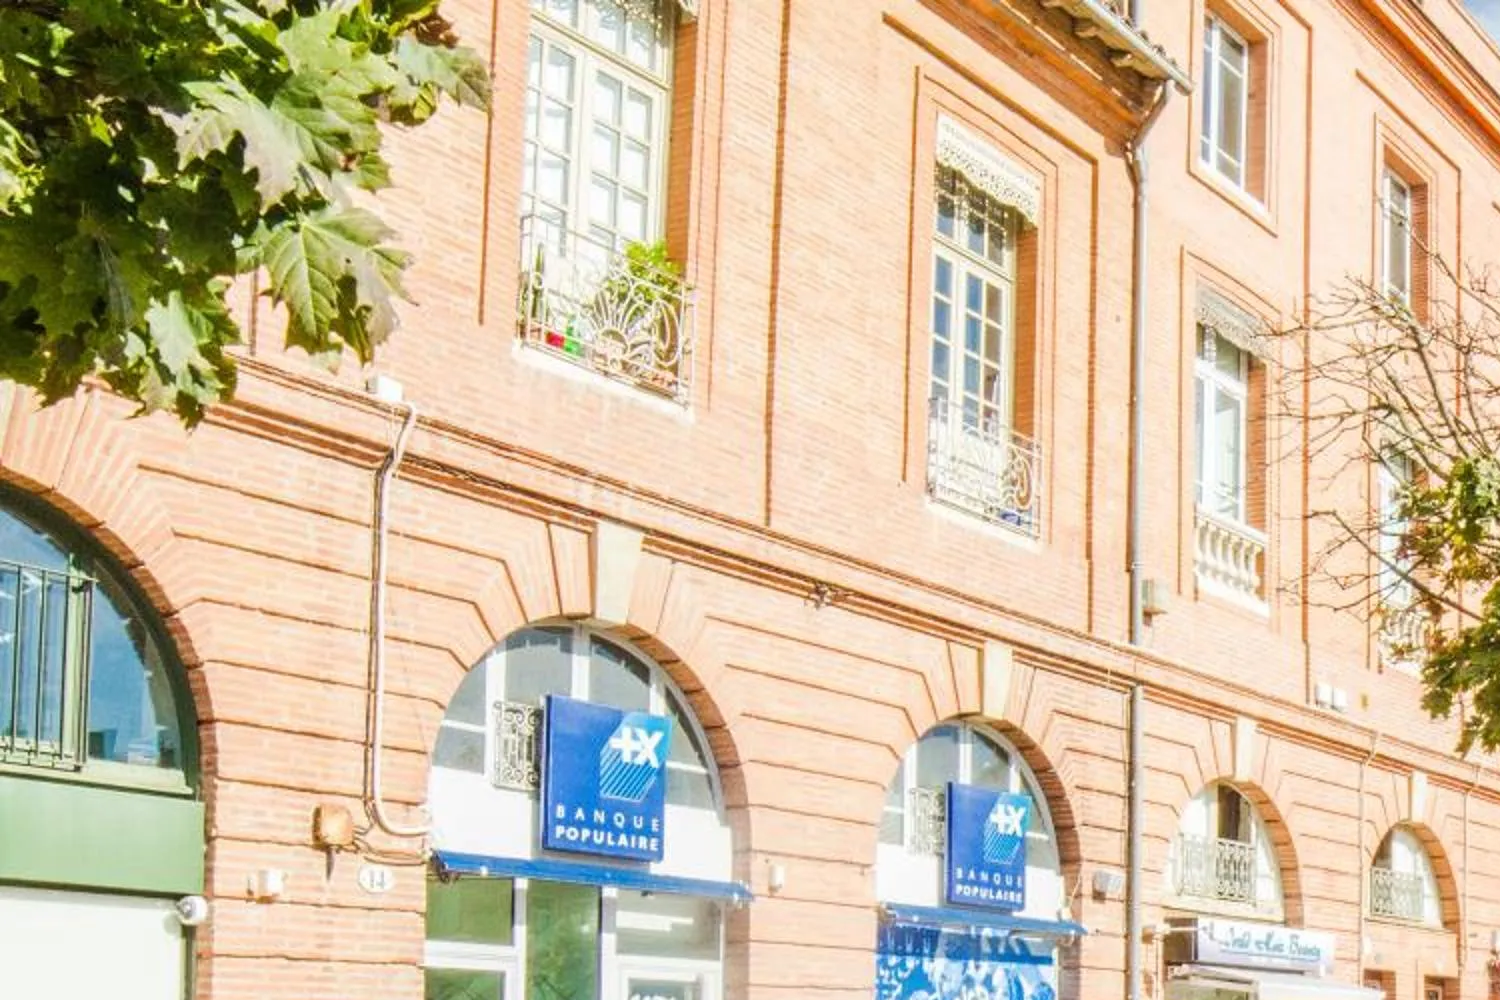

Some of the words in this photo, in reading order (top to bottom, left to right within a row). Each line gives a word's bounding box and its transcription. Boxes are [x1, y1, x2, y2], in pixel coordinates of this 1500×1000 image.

[555, 803, 660, 833] BANQUE
[555, 824, 660, 851] POPULAIRE
[955, 866, 1023, 888] BANQUE
[955, 884, 1023, 903] POPULAIRE
